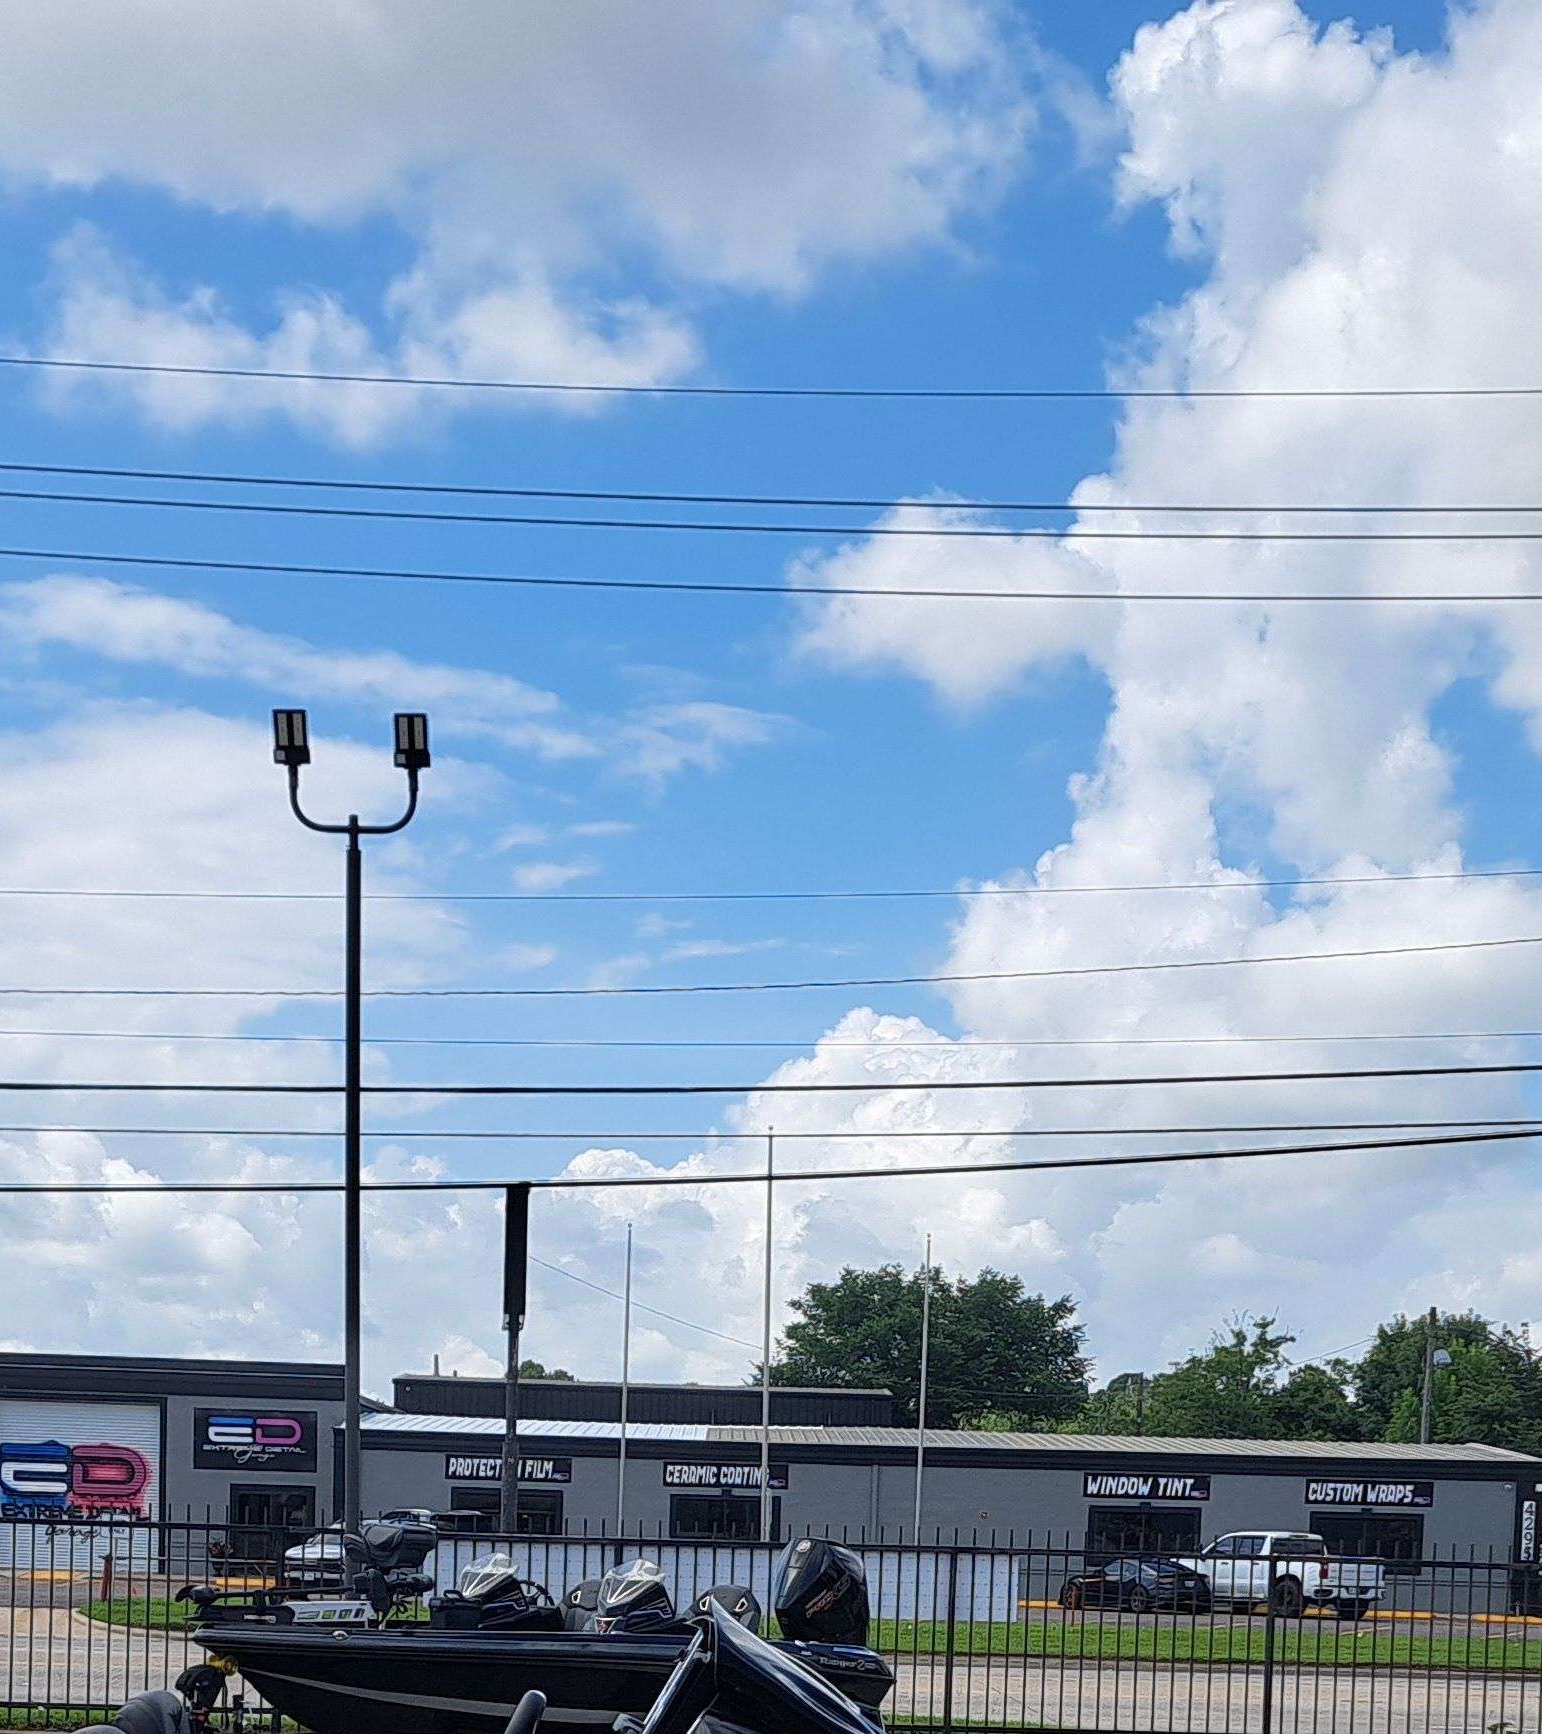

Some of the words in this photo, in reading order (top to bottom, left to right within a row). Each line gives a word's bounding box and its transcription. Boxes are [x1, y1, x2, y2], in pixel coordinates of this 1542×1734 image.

[448, 1458, 522, 1478] PROTECT
[524, 1460, 554, 1479] FILM
[666, 1464, 717, 1484] CERAMIC
[1086, 1475, 1153, 1496] WINDOW
[1157, 1478, 1194, 1496] TINT
[1308, 1482, 1364, 1502] CUSTOM
[1367, 1484, 1414, 1503] WRAPS
[1523, 1502, 1535, 1561] 4295
